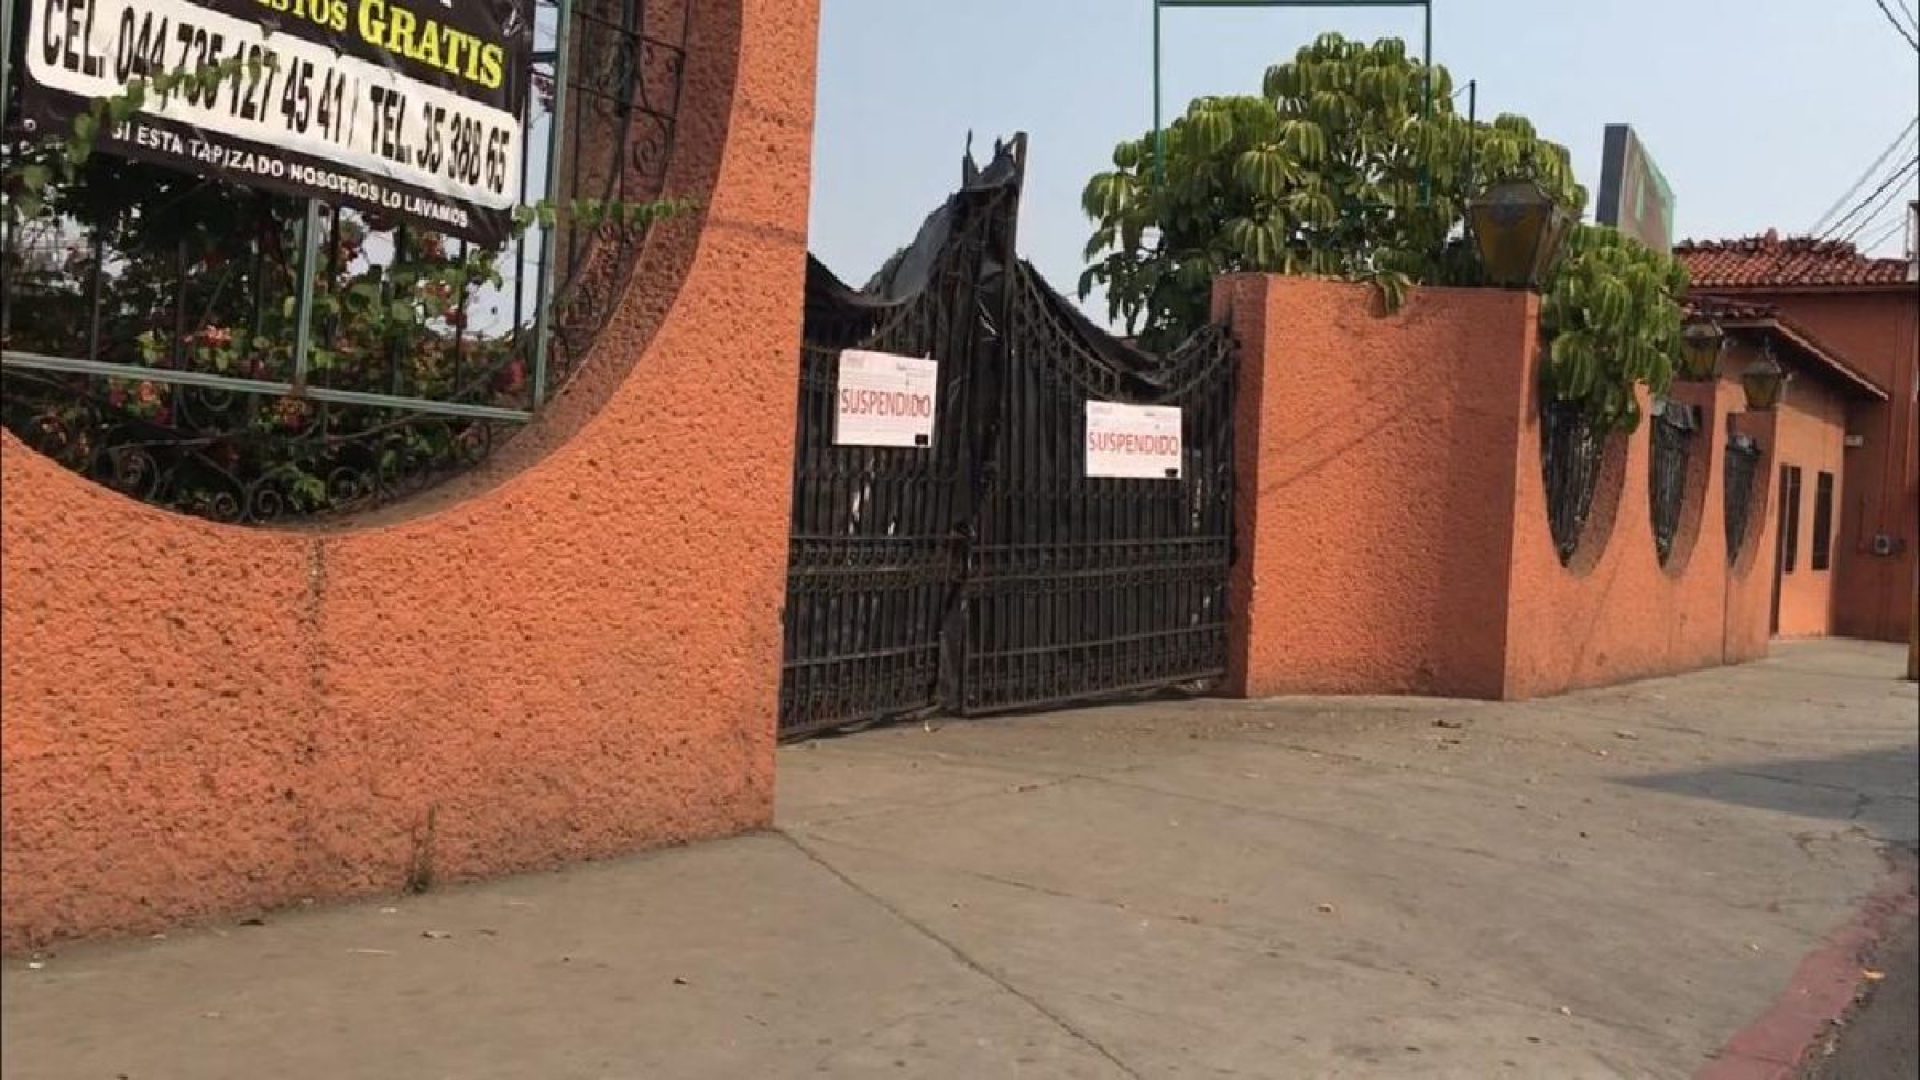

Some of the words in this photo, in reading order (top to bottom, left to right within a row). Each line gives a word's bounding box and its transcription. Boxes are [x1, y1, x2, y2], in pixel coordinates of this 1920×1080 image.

[358, 0, 503, 88] GRATIS
[43, 0, 106, 79] CEL.
[281, 56, 313, 133] 45
[317, 67, 346, 143] 41
[370, 85, 411, 165] TEL.
[416, 101, 446, 173] 35
[448, 112, 482, 186] 388
[486, 126, 509, 194] 65
[137, 125, 183, 154] ESTA
[188, 138, 284, 177] TAPIZADO
[290, 164, 380, 203] NOSOTROS
[381, 188, 402, 208] LO
[404, 194, 468, 228] LAVAMOS
[841, 389, 931, 418] SUSPENDIDO
[1088, 431, 1178, 456] SUSPENDIDO
